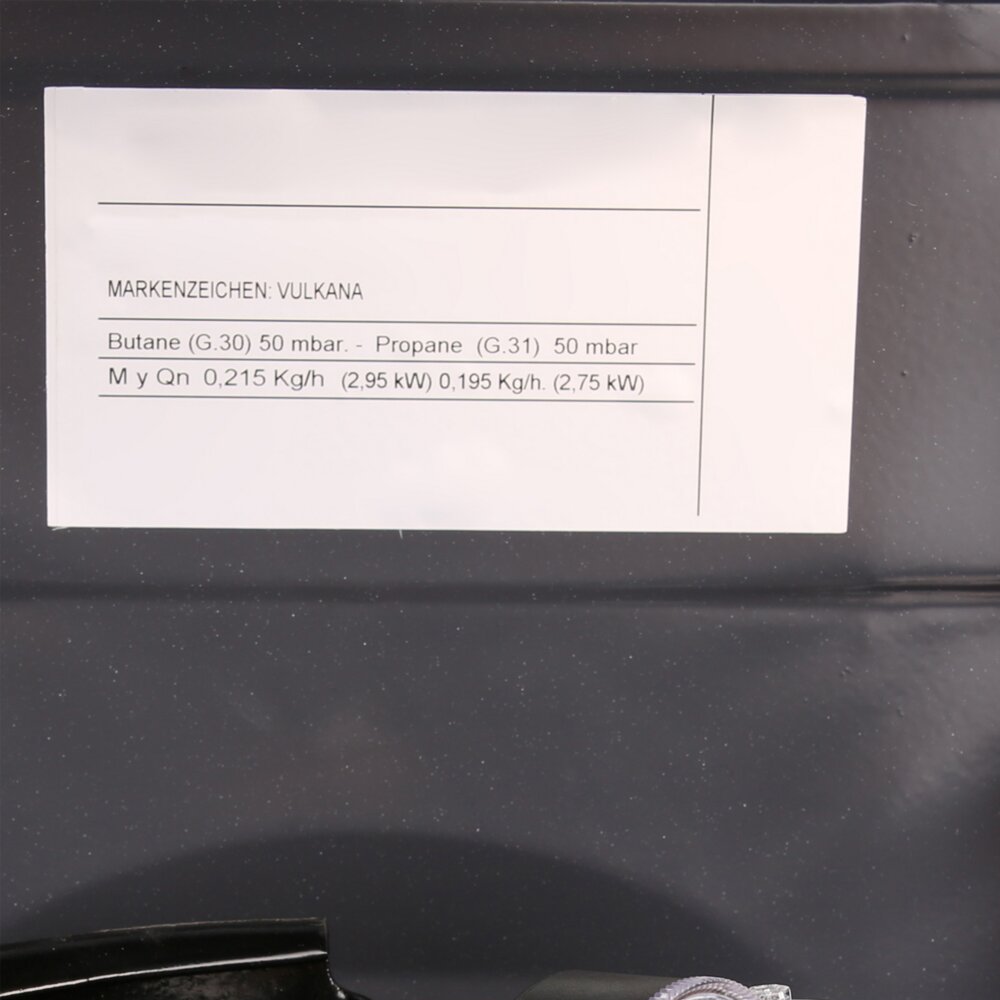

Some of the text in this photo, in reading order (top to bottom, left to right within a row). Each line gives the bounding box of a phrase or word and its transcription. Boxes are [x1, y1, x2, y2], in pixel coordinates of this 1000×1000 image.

[108, 280, 363, 300] MARKENZEICHEN: VULKANA
[108, 333, 180, 350] Butane
[189, 334, 251, 355] (G.30)
[260, 334, 284, 351] 50
[292, 335, 348, 352] mbar.
[376, 336, 462, 357] Propane
[477, 337, 540, 358] (G.31)
[554, 337, 578, 354] 50
[586, 338, 638, 355] mbar
[109, 368, 645, 395] M y Qn 0,215 Kg/h (2,95 kW) 0,195 Kg/h. (2,75 kW)
